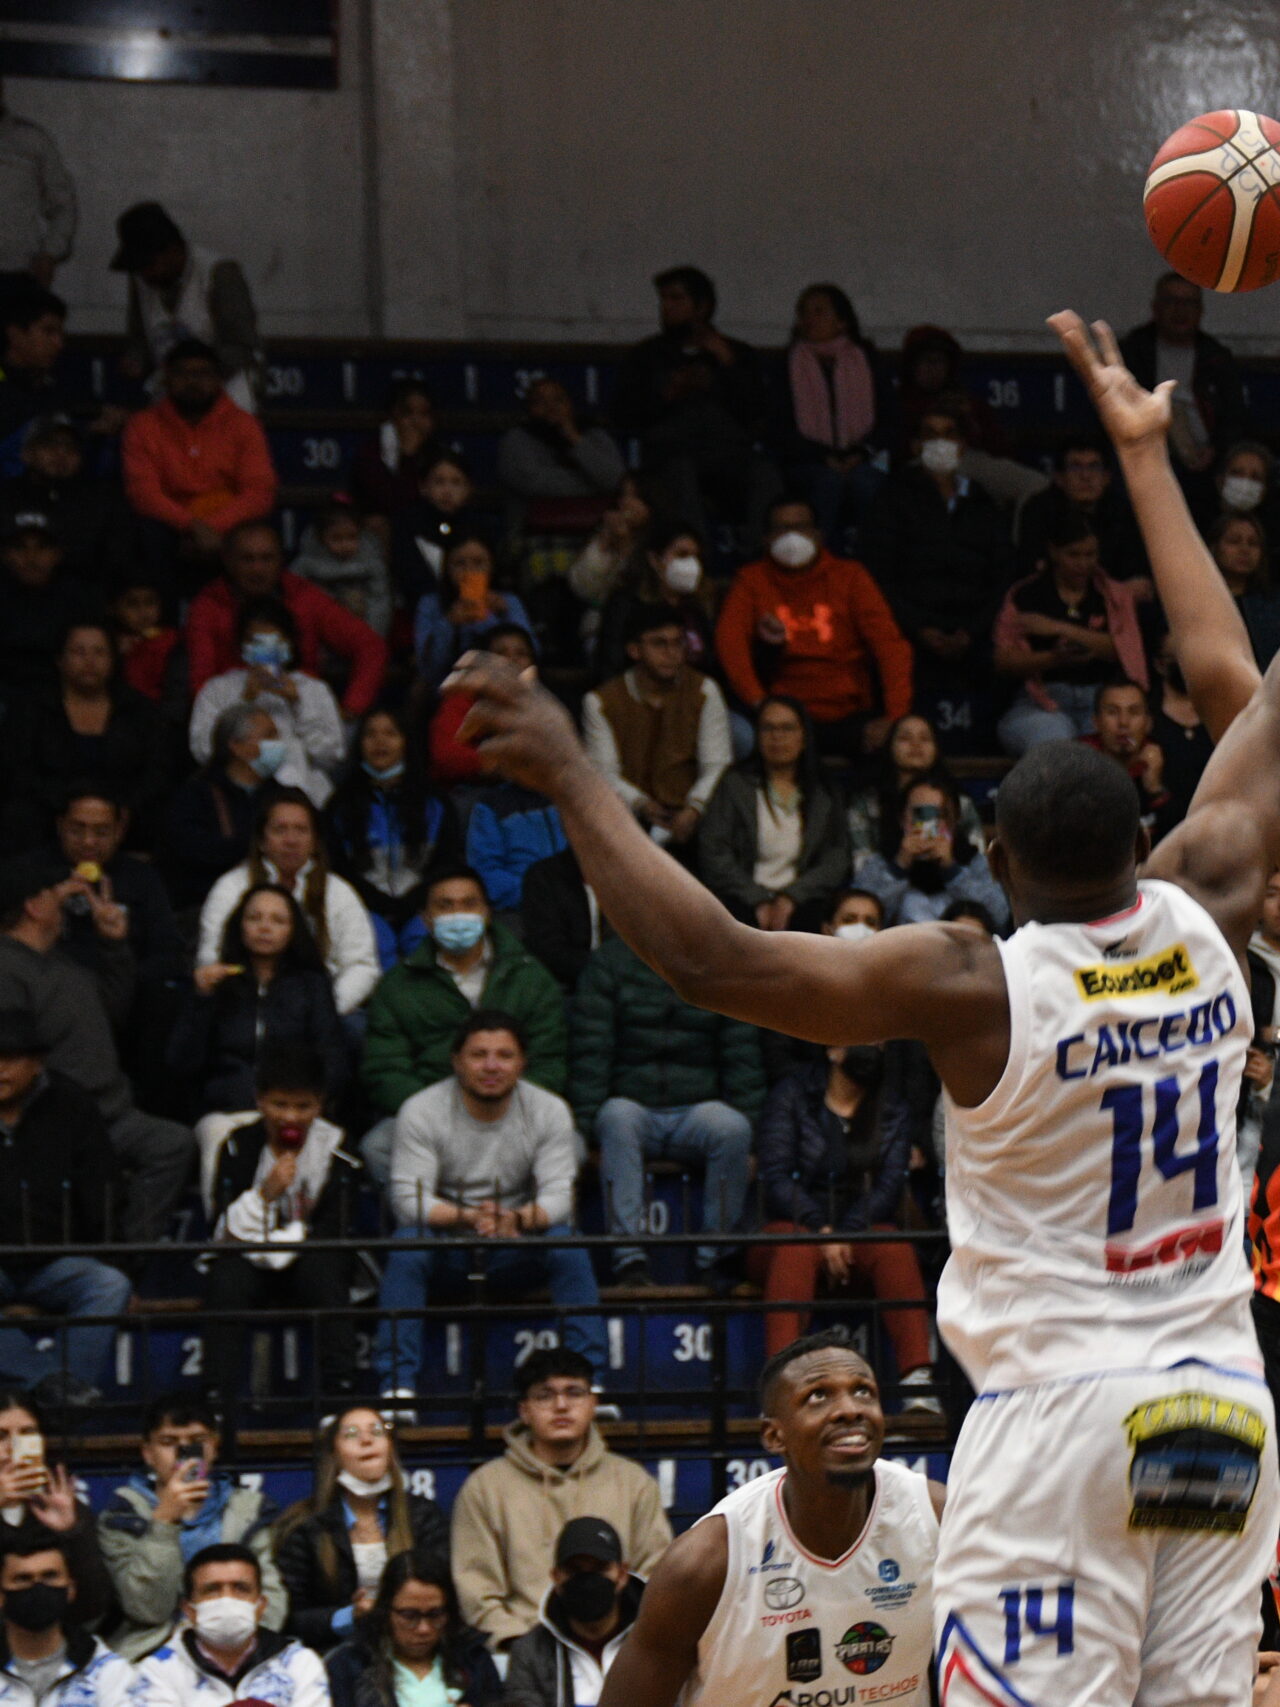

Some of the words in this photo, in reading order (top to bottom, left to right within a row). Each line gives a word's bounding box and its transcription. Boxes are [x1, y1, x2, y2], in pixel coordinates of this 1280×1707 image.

[302, 437, 341, 470] 30
[1100, 1059, 1220, 1235] 14
[760, 1609, 811, 1627] TOYOTA
[997, 1580, 1076, 1666] 14
